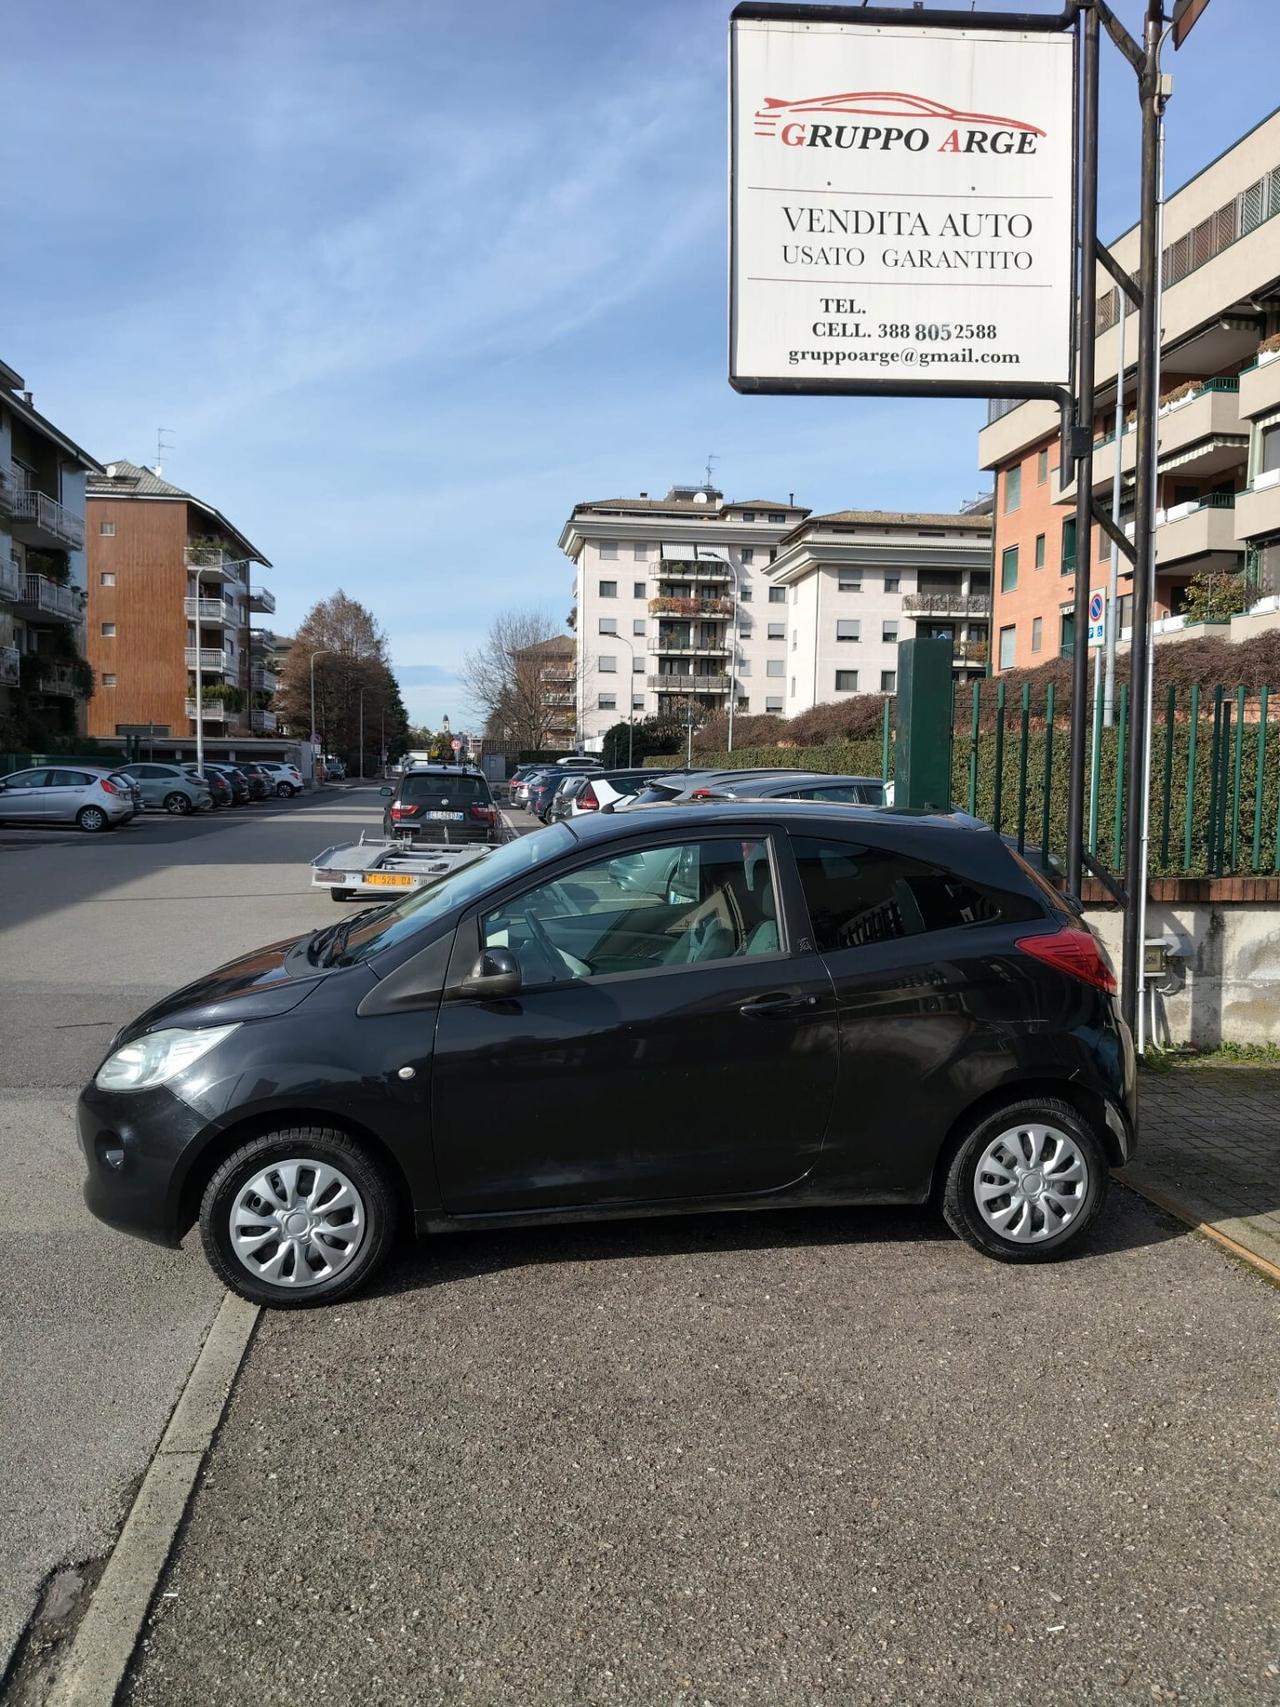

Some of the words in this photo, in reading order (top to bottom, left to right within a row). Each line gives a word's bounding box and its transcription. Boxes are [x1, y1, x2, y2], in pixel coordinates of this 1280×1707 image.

[781, 122, 930, 152] GRUPPO
[937, 128, 1039, 155] ARGE
[781, 206, 931, 237] VENDITA
[939, 213, 1033, 239] AUTO
[782, 245, 865, 267] USATO
[882, 249, 1033, 271] GARANTITO
[820, 298, 867, 314] TEL.
[812, 322, 872, 338] CELL.
[788, 347, 1020, 367] gruppoarge@gmail.com
